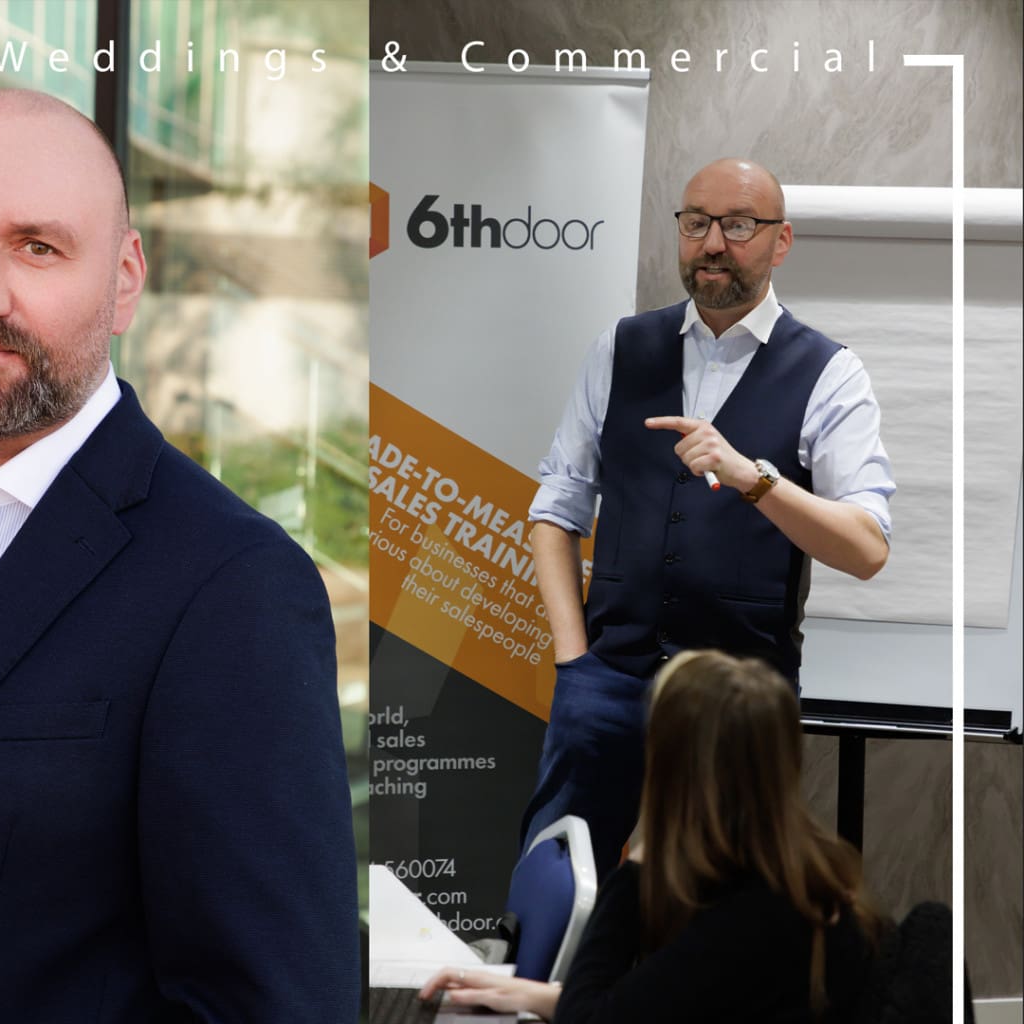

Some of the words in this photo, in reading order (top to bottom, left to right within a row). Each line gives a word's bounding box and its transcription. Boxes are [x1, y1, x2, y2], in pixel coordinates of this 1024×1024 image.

[407, 195, 605, 250] 6thdoor
[380, 507, 409, 535] For
[410, 523, 498, 589] businesses
[499, 577, 534, 609] that
[443, 512, 537, 587] TRAINI
[369, 529, 407, 561] rious
[409, 555, 461, 592] about
[460, 577, 554, 650] developing
[401, 574, 440, 606] their
[441, 600, 542, 666] salespeople
[369, 705, 408, 728] orld,
[377, 729, 426, 748] sales
[373, 757, 496, 777] programmes
